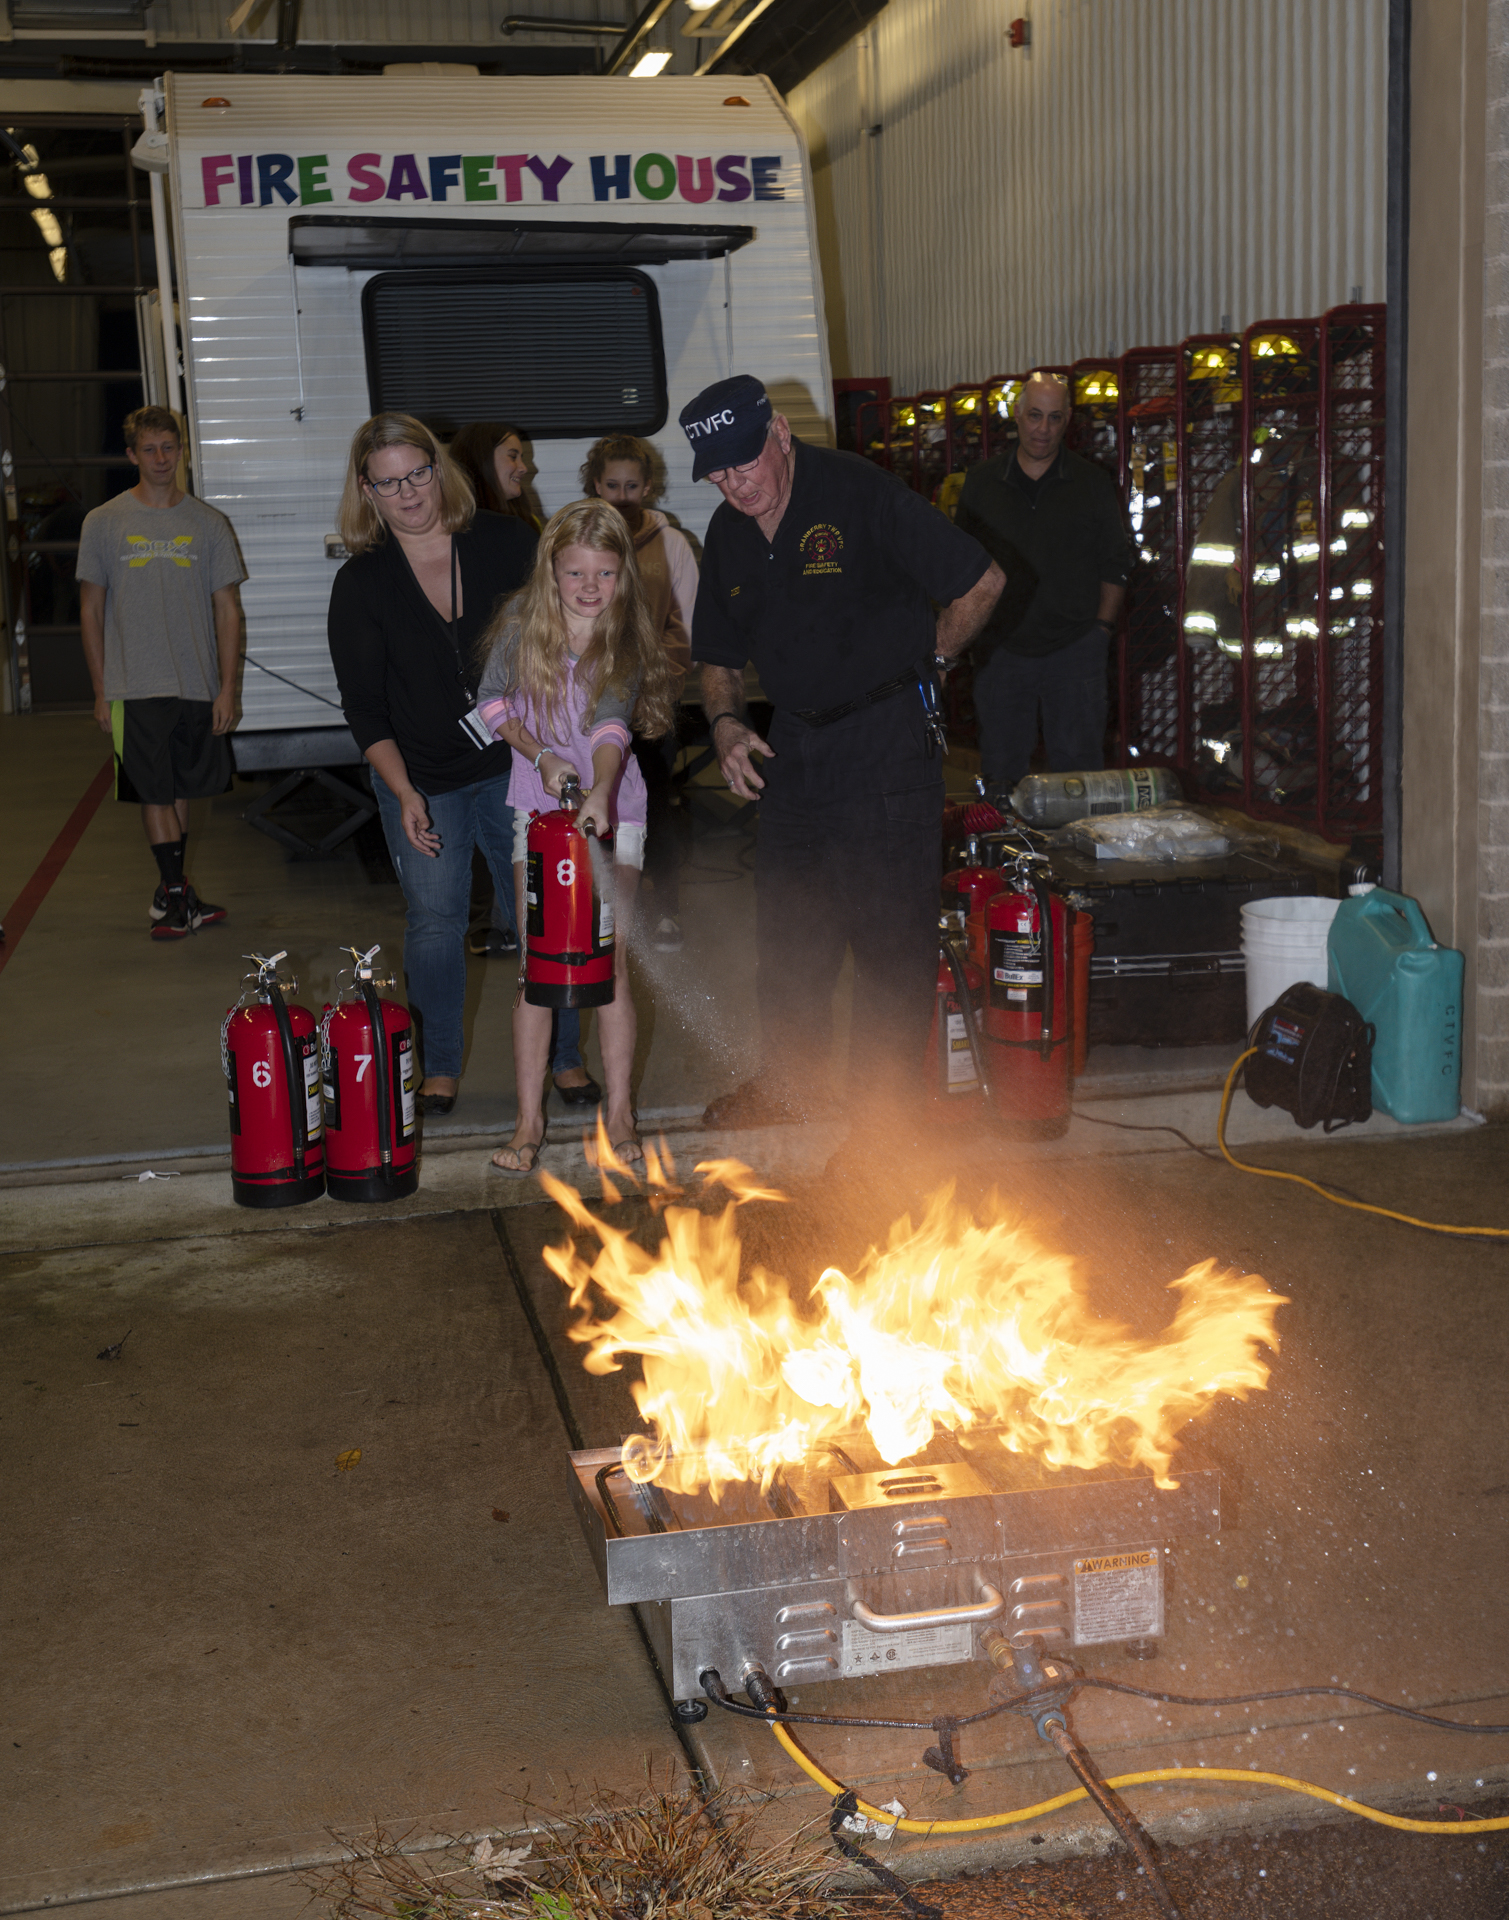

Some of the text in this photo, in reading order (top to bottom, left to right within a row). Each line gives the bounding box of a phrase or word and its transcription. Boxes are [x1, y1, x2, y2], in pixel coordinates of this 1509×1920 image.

[201, 152, 786, 207] FIRE SAFETY HOUSE
[685, 409, 735, 439] CTVFC
[556, 858, 576, 887] 8
[252, 1061, 272, 1088] 6
[354, 1054, 372, 1082] 7
[1091, 1553, 1151, 1571] WARNING
